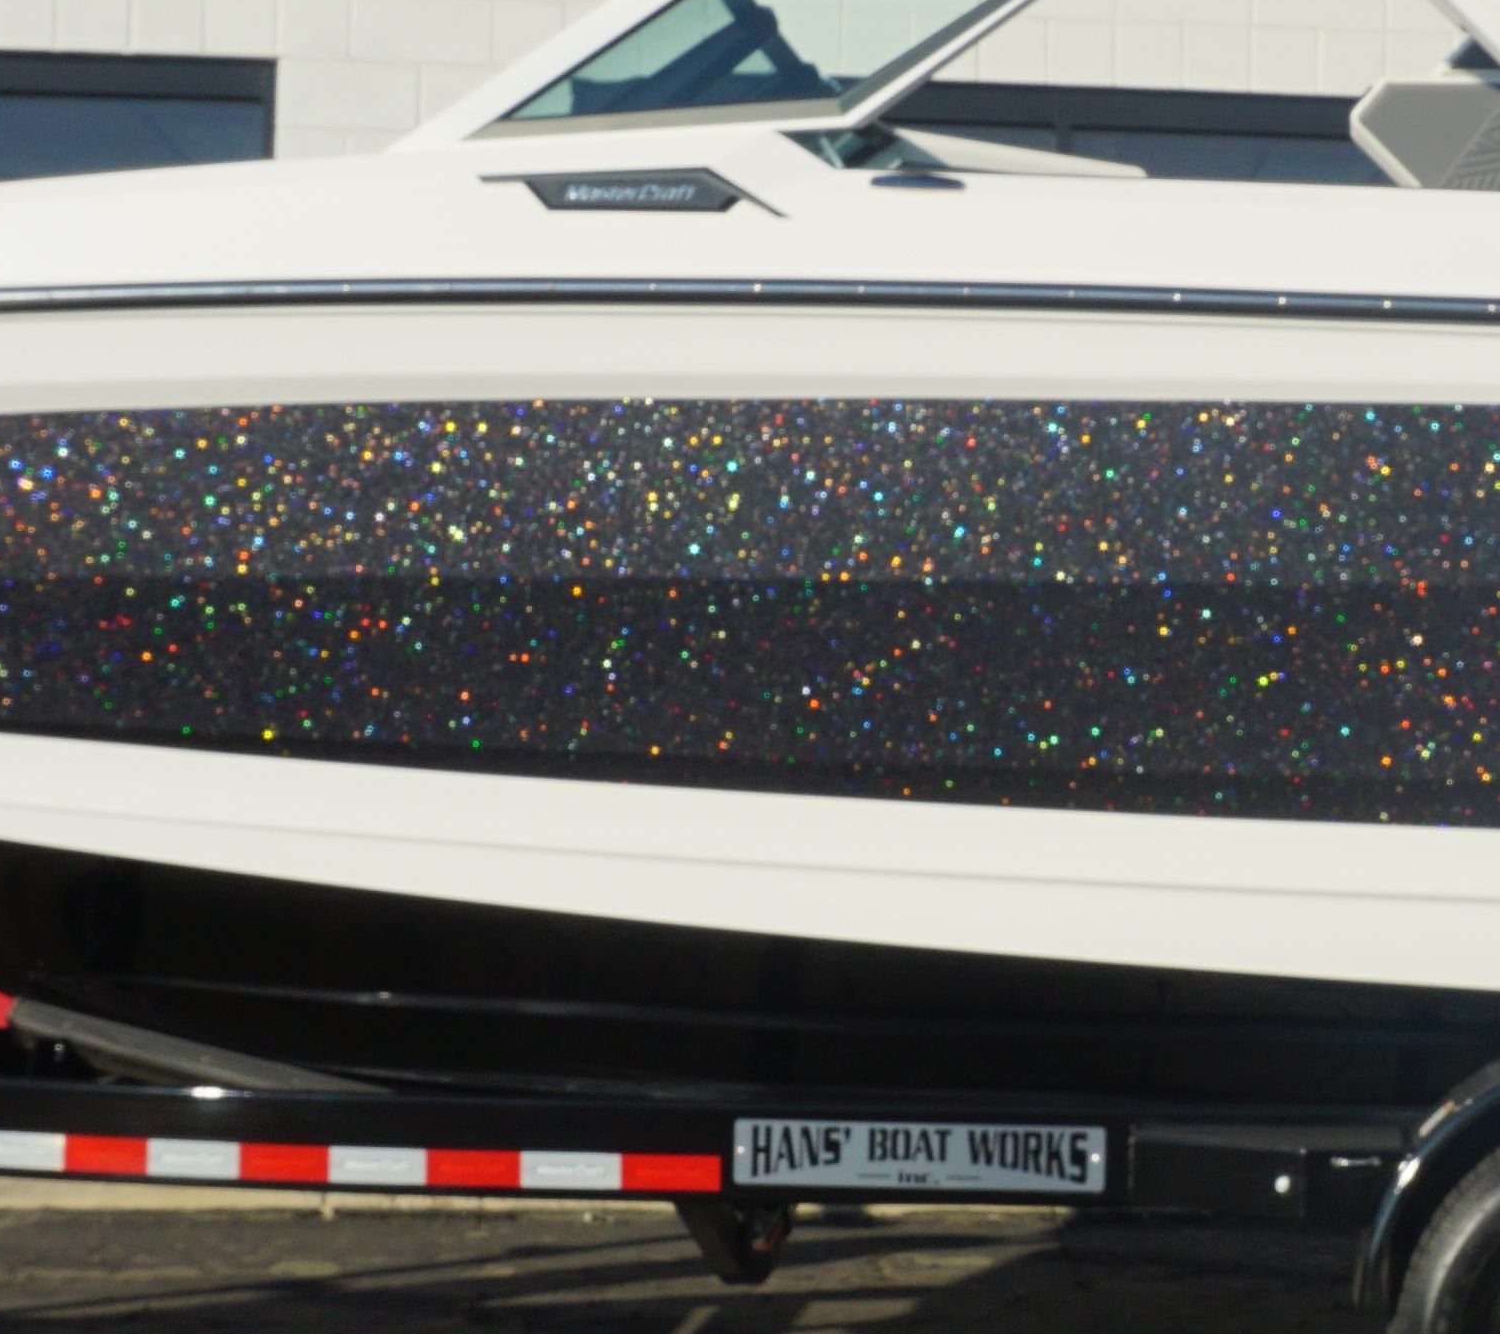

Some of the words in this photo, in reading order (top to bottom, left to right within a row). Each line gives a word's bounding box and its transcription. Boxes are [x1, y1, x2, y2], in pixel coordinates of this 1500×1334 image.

[751, 1124, 852, 1177] HANS'
[869, 1128, 953, 1162] BOAT
[968, 1131, 1088, 1185] WORKS
